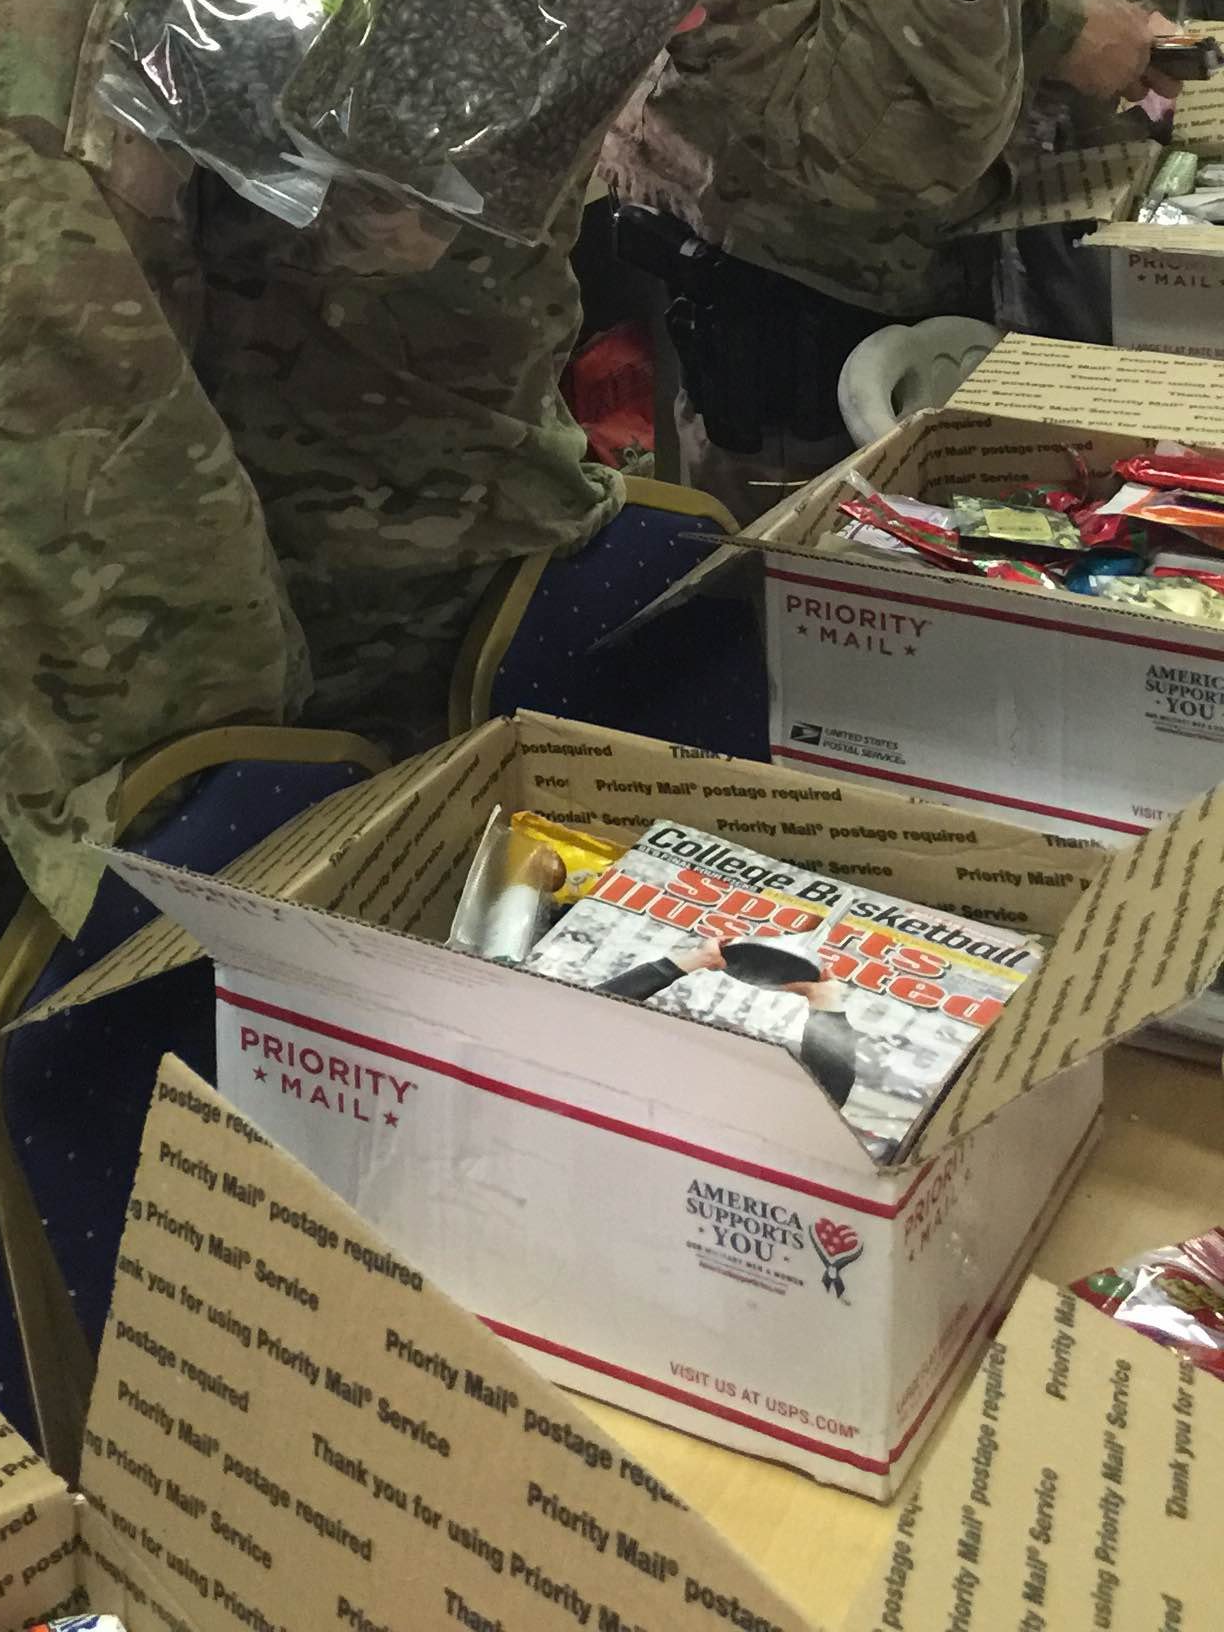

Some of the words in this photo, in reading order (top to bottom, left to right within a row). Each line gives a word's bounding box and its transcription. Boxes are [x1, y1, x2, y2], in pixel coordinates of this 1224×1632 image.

[1154, 272, 1210, 289] MAIL
[786, 594, 927, 638] PRIORITY
[820, 626, 893, 656] MAIL
[1145, 679, 1224, 705] SUPPORT
[1146, 664, 1224, 691] AMERIC
[1166, 697, 1215, 721] YOU
[823, 740, 860, 756] POSTAL
[824, 727, 863, 743] UNITED
[864, 734, 899, 751] STATES
[596, 778, 652, 796] Priority
[703, 784, 767, 800] postage
[771, 787, 842, 802] required
[1131, 804, 1164, 821] VISIT
[717, 818, 777, 836] Priority
[830, 825, 897, 841] postage
[903, 828, 978, 844] required
[647, 824, 797, 892] College
[240, 1025, 411, 1105] PRIORITY
[281, 1072, 370, 1124] MAIL
[159, 1140, 219, 1193] Priority
[269, 1201, 339, 1249] postage
[343, 1237, 424, 1292] required
[686, 1196, 805, 1251] SUPPORTS
[687, 1178, 804, 1231] AMERICA
[146, 1200, 205, 1252] Priority
[253, 1258, 320, 1313] Service
[711, 1224, 775, 1263] YOU
[115, 1319, 176, 1370] postage
[179, 1356, 250, 1414] required
[118, 1254, 145, 1283] ank
[147, 1269, 177, 1301] you
[180, 1284, 205, 1315] for
[207, 1304, 252, 1348] using
[256, 1326, 321, 1386] Priority
[376, 1396, 452, 1459] Service
[669, 1359, 711, 1387] VISIT
[714, 1377, 737, 1398] US
[741, 1386, 761, 1406] AT
[980, 1341, 1008, 1421] required
[384, 1326, 460, 1391] Priority
[523, 1407, 614, 1471] postage
[1106, 1358, 1133, 1430] Service
[1173, 1380, 1195, 1417] for
[970, 1423, 999, 1508] postage
[1174, 1418, 1196, 1460] you
[117, 1378, 175, 1436] Priority
[222, 1452, 291, 1510] postage
[294, 1497, 373, 1564] required
[1164, 1458, 1191, 1520] Thank
[311, 1431, 369, 1489] Thank
[372, 1472, 409, 1511] you
[413, 1493, 444, 1530] for
[447, 1518, 506, 1575] using
[510, 1551, 594, 1626] Priority
[1095, 1485, 1125, 1566] Priority
[1090, 1568, 1121, 1631] using
